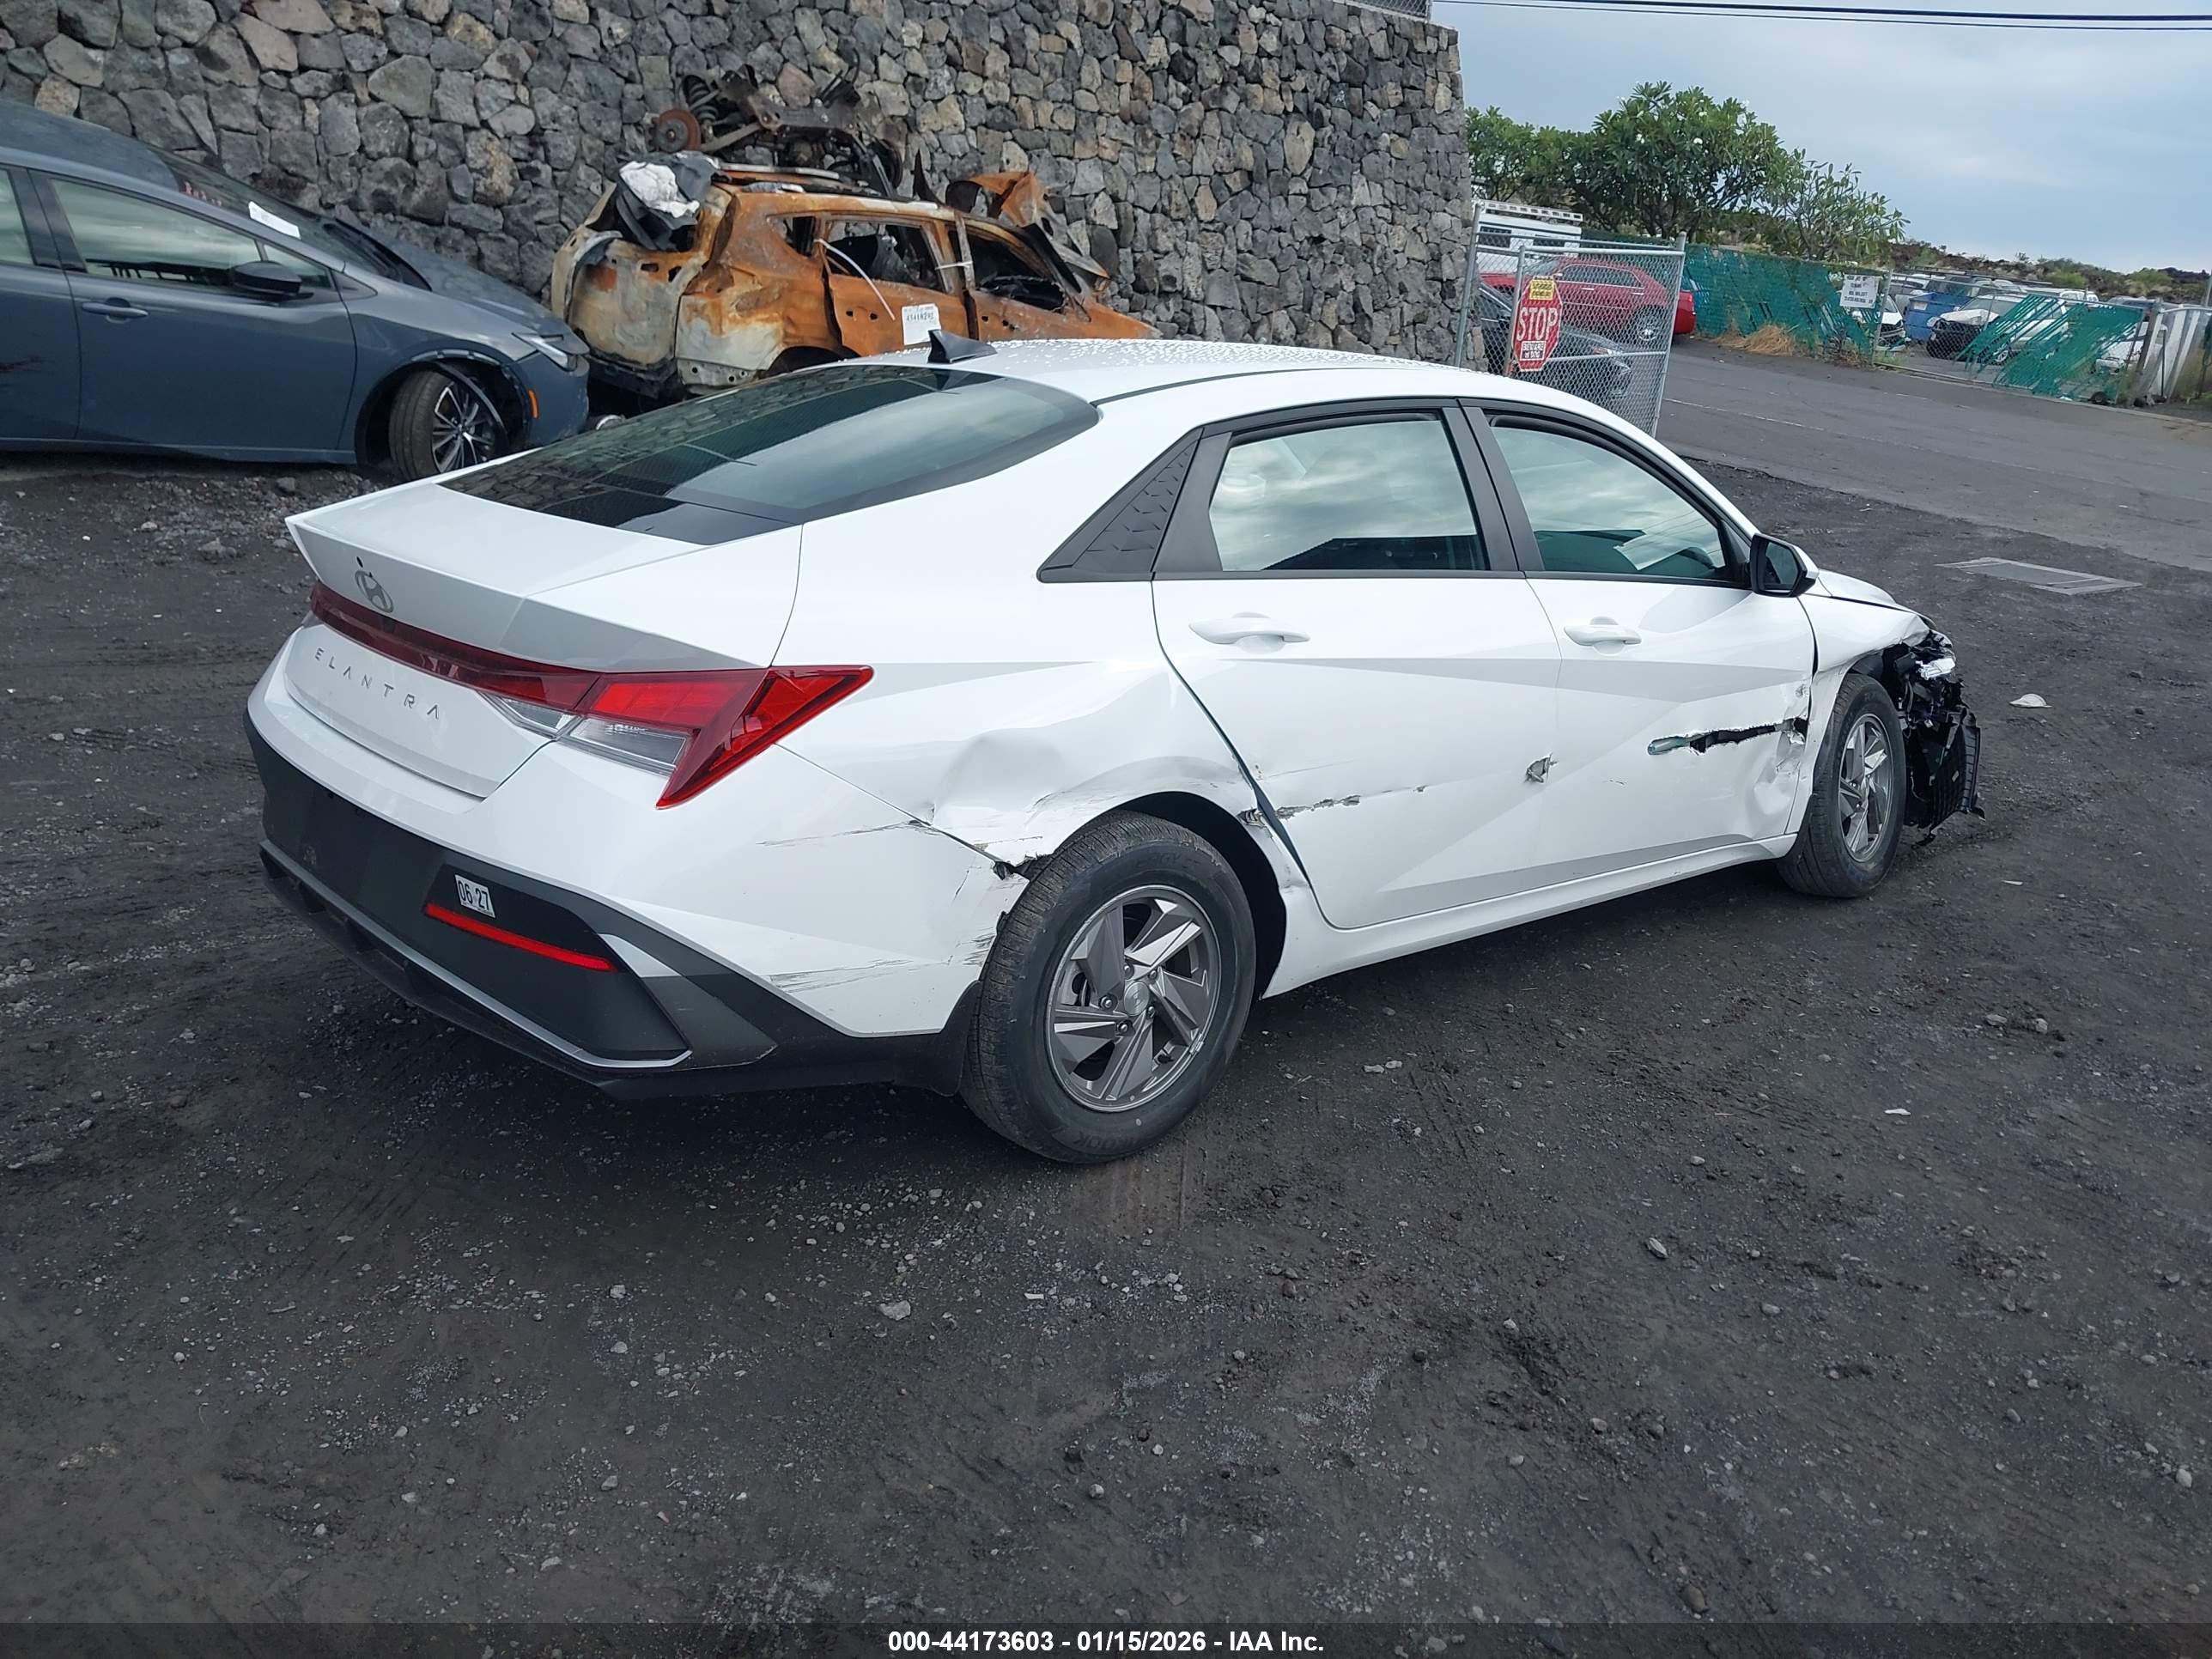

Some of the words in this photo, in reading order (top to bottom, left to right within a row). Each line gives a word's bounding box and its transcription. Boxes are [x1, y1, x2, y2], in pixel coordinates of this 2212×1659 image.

[1516, 307, 1559, 341] STOP
[314, 647, 440, 720] ELANTRA
[458, 880, 473, 904] 06
[475, 888, 489, 911] 27
